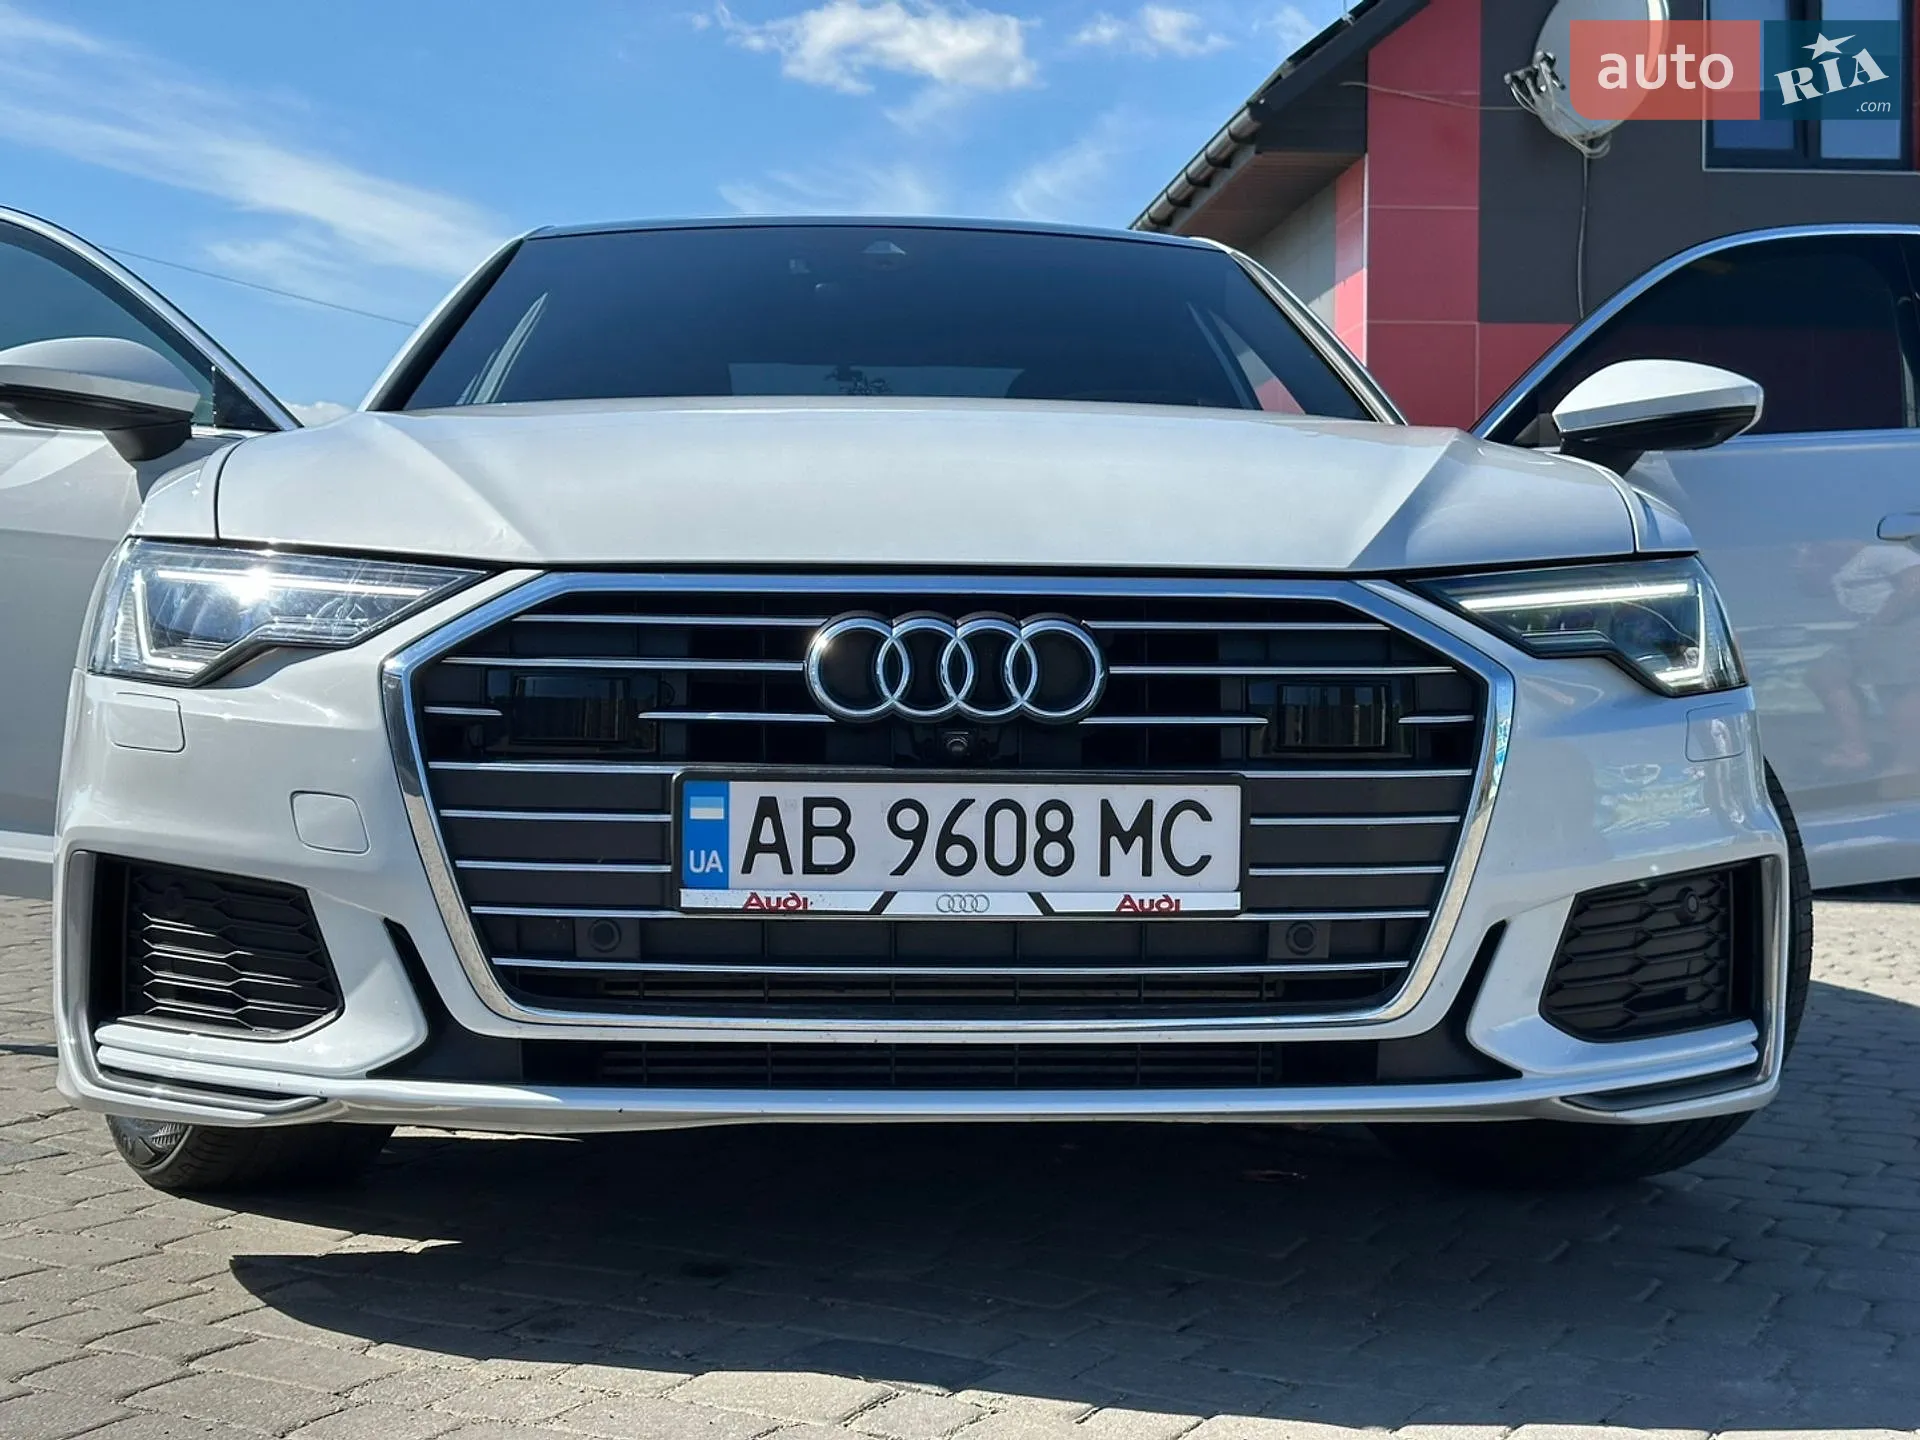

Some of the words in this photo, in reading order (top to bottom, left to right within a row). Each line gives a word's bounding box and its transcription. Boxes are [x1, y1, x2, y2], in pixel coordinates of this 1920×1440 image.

[741, 796, 856, 875] AB
[887, 798, 1075, 877] 9608
[1099, 798, 1213, 877] MC
[690, 850, 723, 873] UA
[743, 892, 808, 912] Audi
[1115, 894, 1181, 912] Audi
